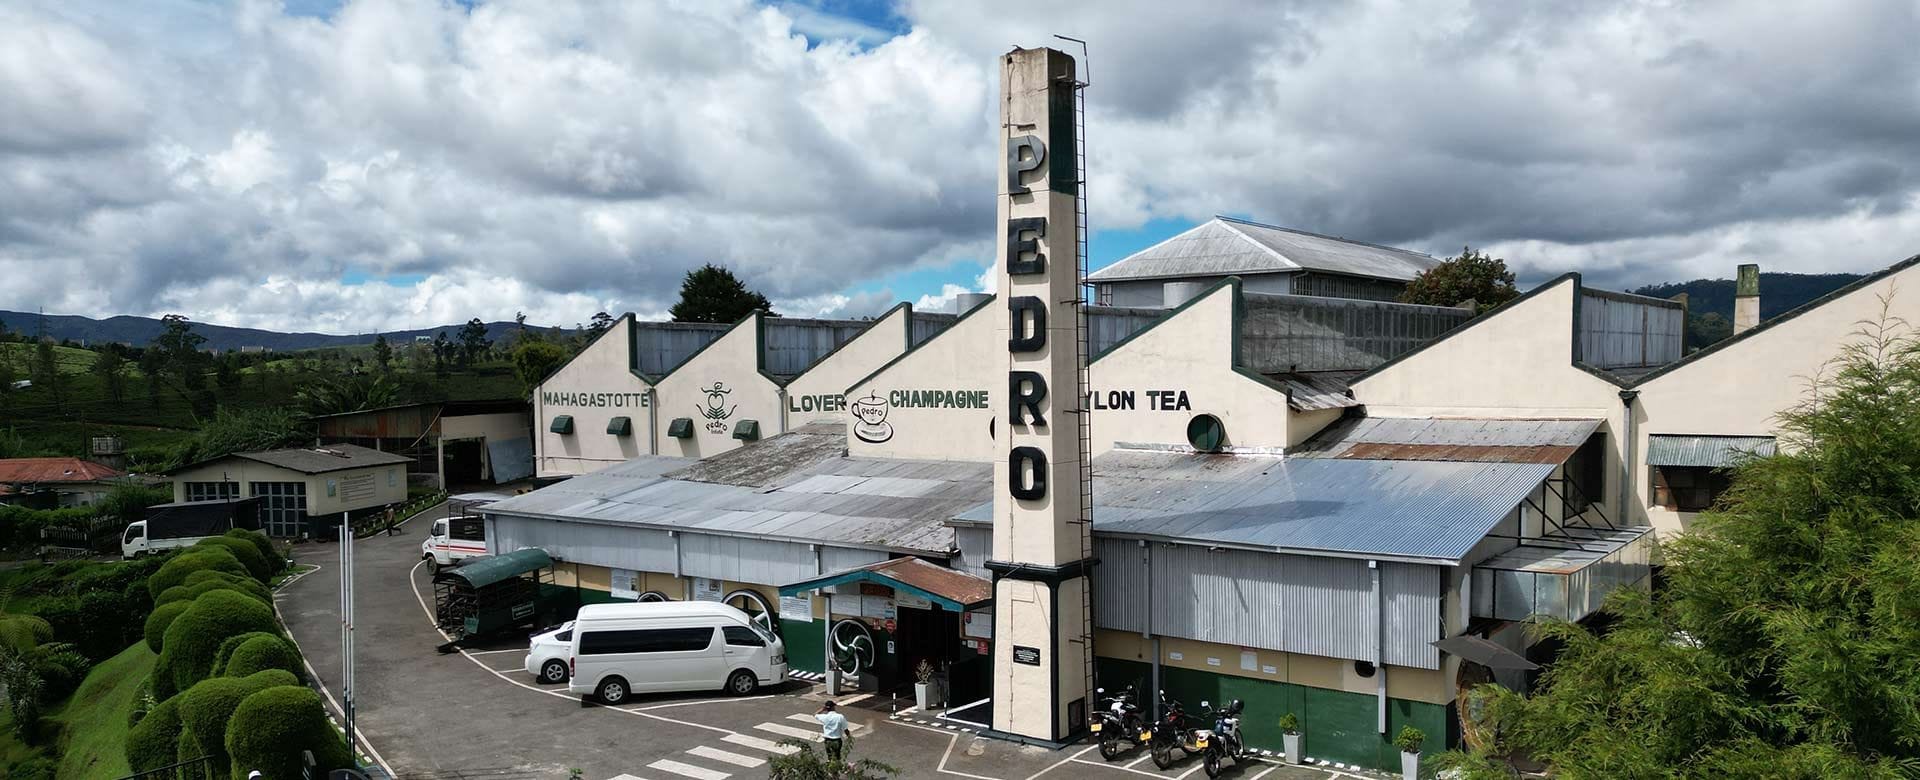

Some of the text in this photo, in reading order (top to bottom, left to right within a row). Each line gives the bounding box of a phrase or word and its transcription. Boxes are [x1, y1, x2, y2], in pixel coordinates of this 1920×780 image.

[1007, 135, 1046, 500] PEDRO
[543, 391, 649, 407] MAHAGASTOTTE
[789, 394, 846, 412] LOVER
[889, 389, 1192, 411] CHAMPAGNE YLON TEA
